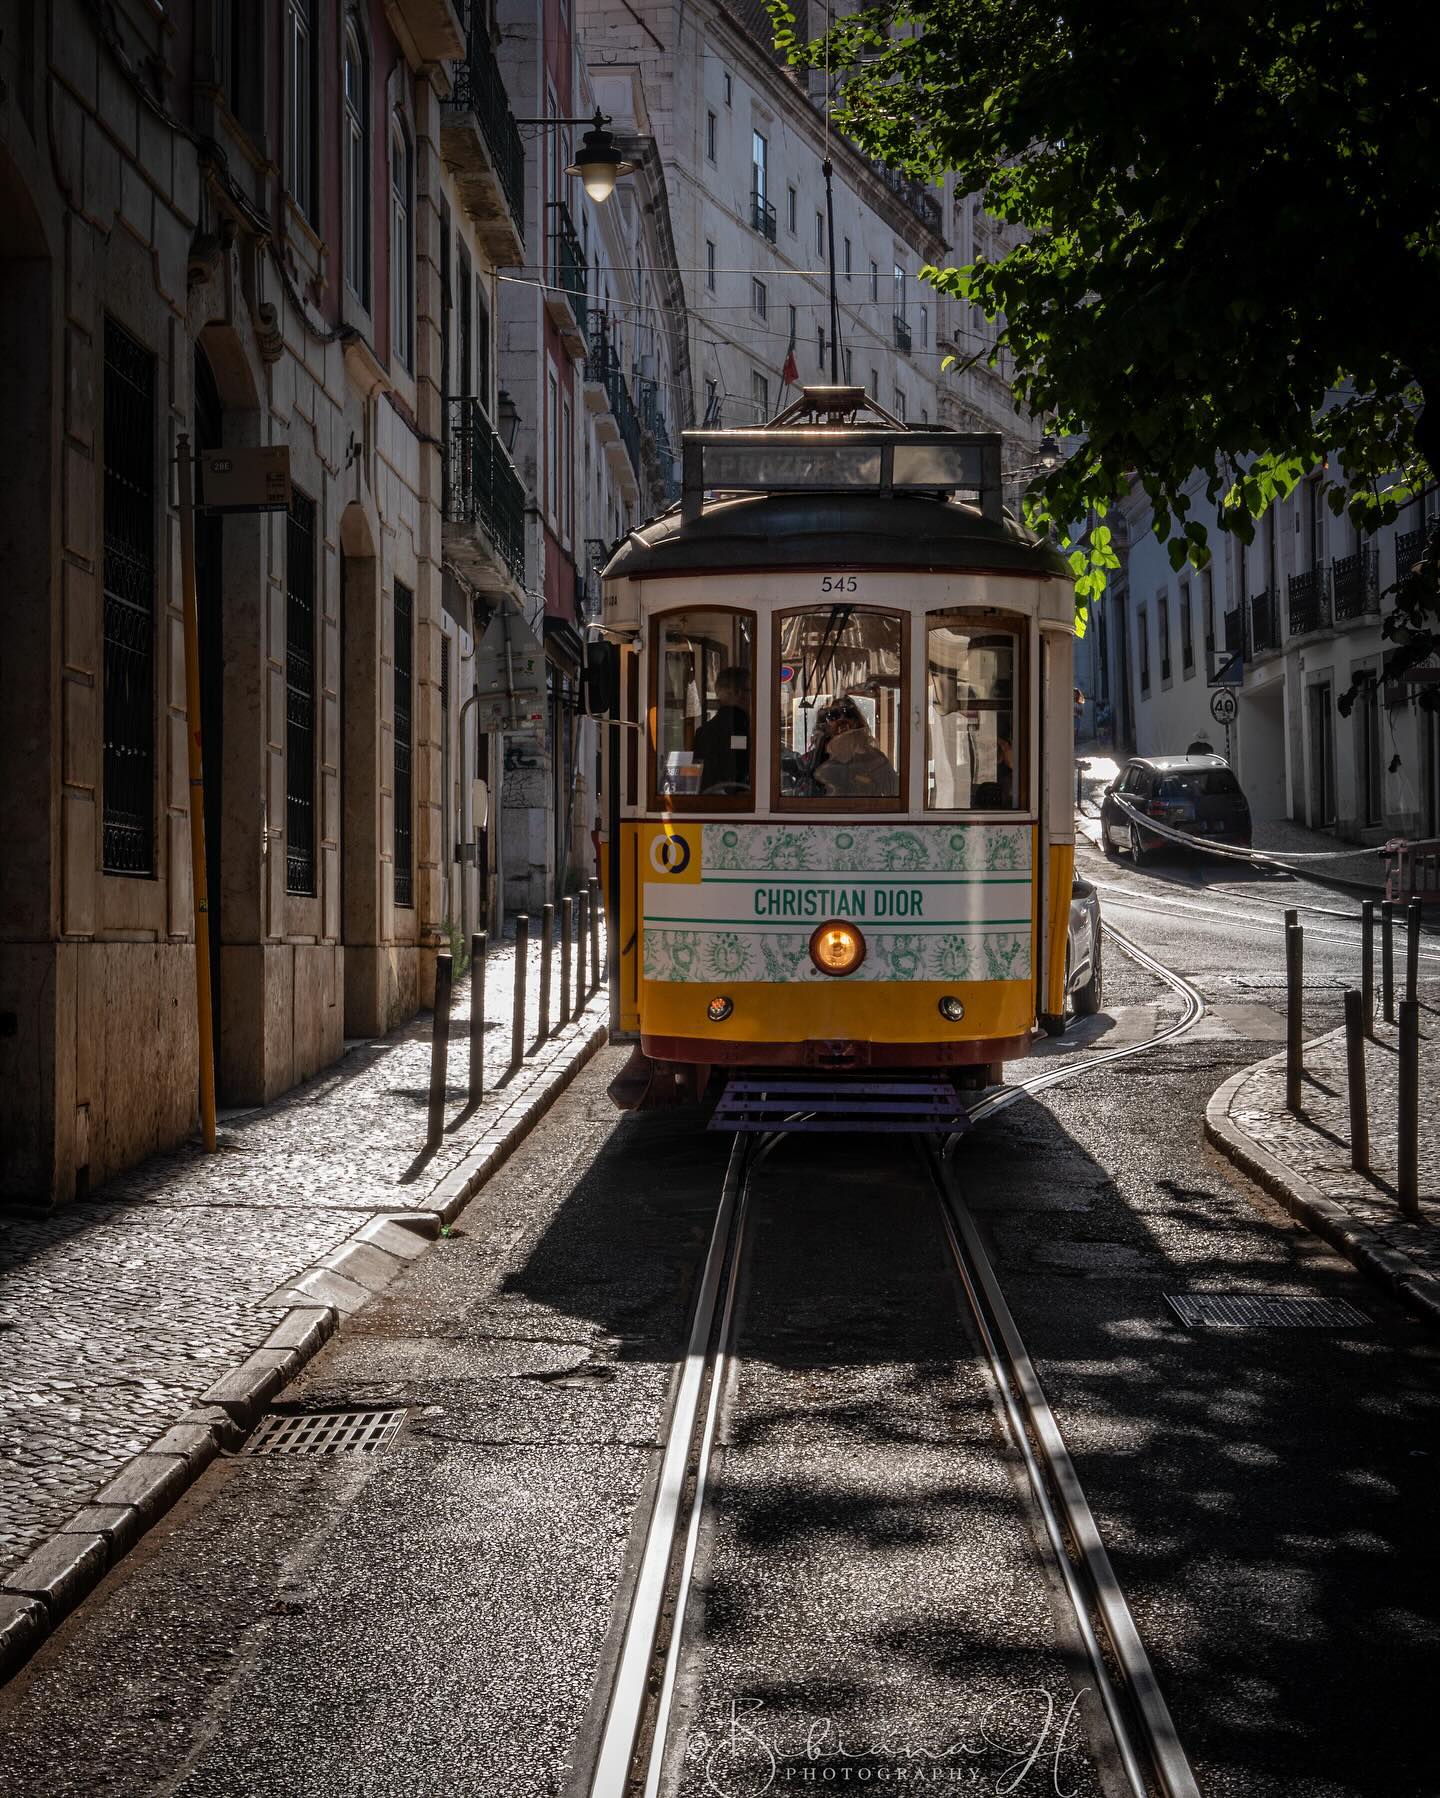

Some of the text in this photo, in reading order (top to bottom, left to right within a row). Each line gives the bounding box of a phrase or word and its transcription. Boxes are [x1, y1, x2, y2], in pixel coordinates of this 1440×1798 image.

[821, 576, 857, 592] 545
[1215, 699, 1234, 713] 40
[754, 888, 923, 916] CHRISTIAN DIOR
